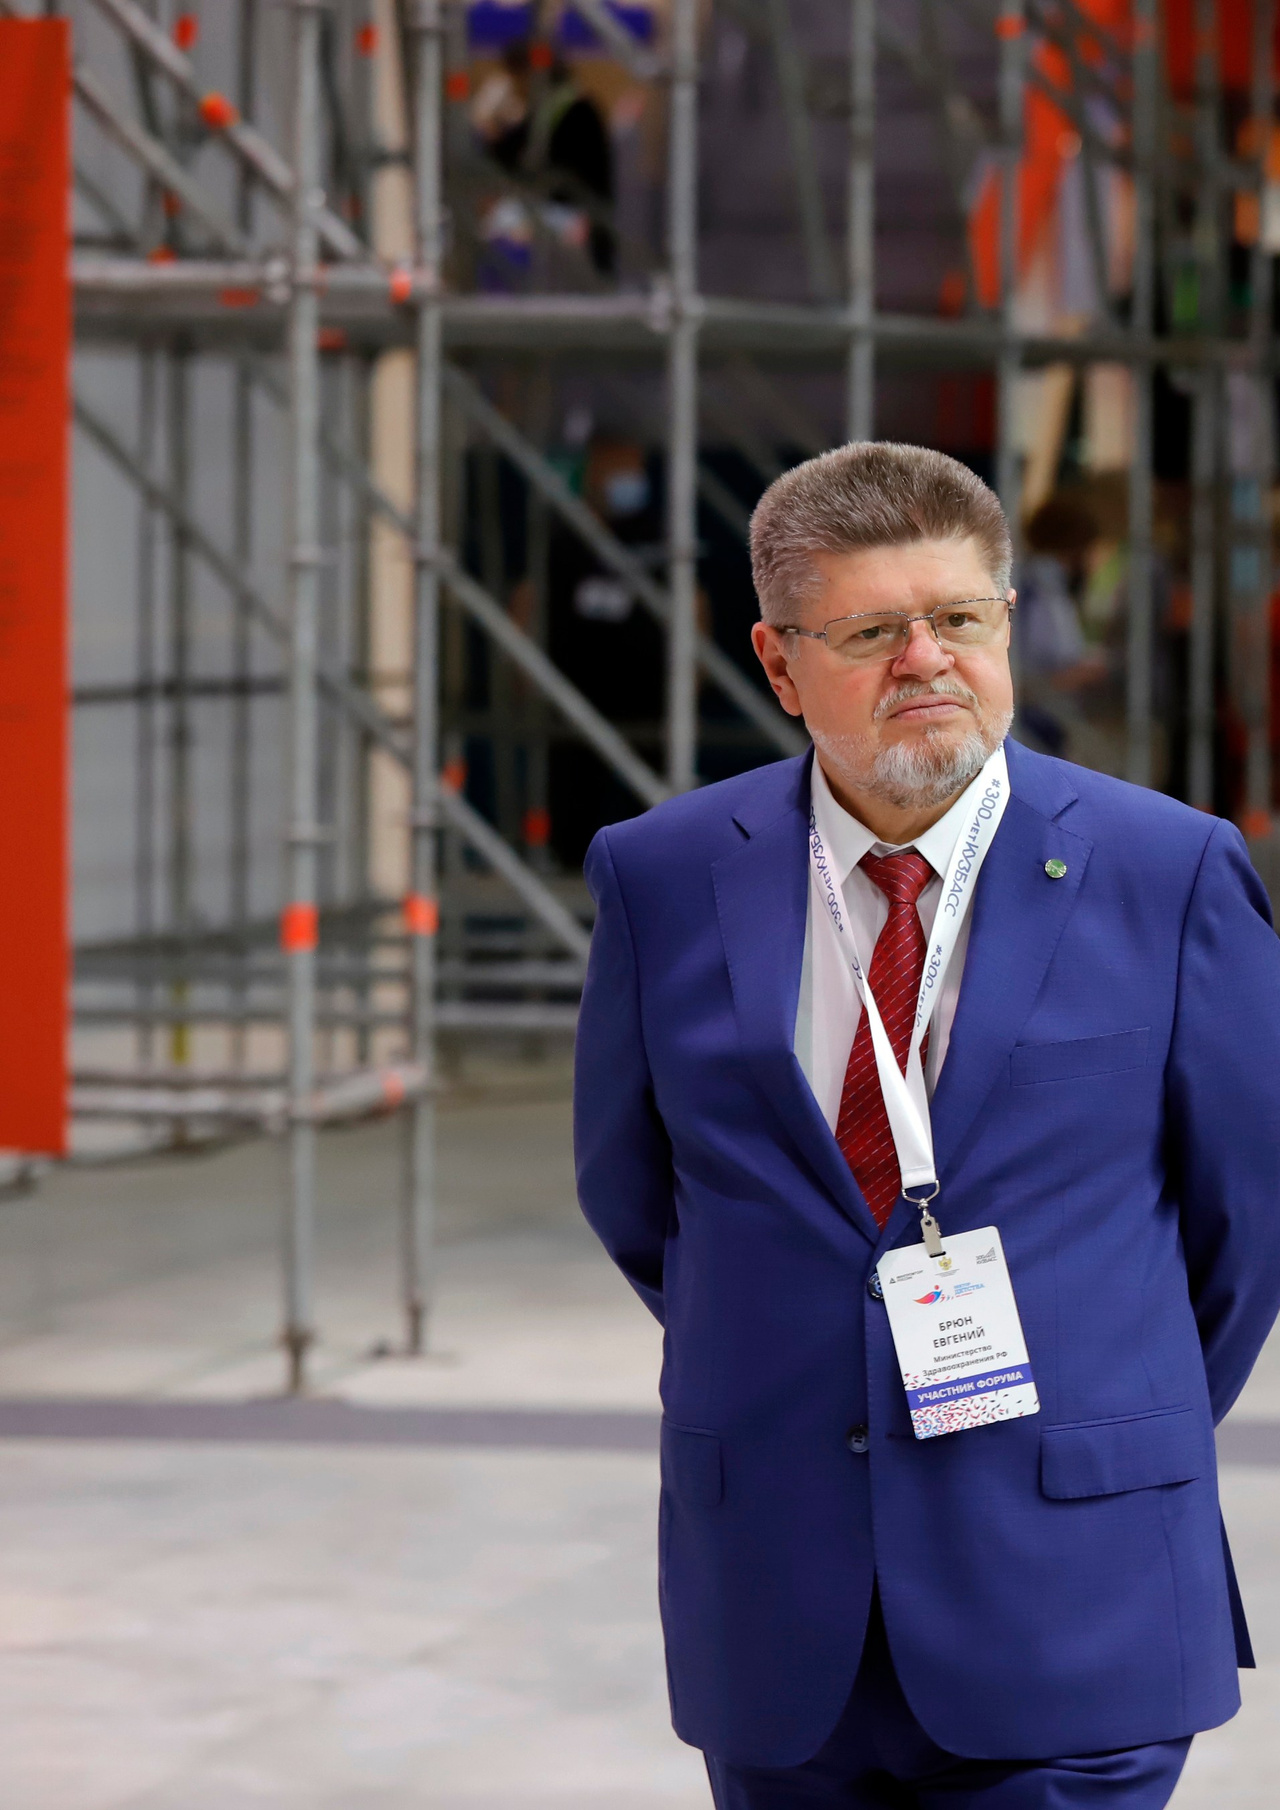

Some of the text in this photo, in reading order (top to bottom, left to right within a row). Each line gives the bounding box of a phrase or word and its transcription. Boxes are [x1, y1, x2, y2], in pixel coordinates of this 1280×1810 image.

[938, 1316, 973, 1331] БРЮН
[933, 1326, 985, 1348] ЕВГЕНИЙ
[922, 1351, 1008, 1377] Здравоохранения РФ
[933, 1345, 992, 1363] Министерство
[917, 1371, 1024, 1403] УЧАСТНИК ФОРУМА
